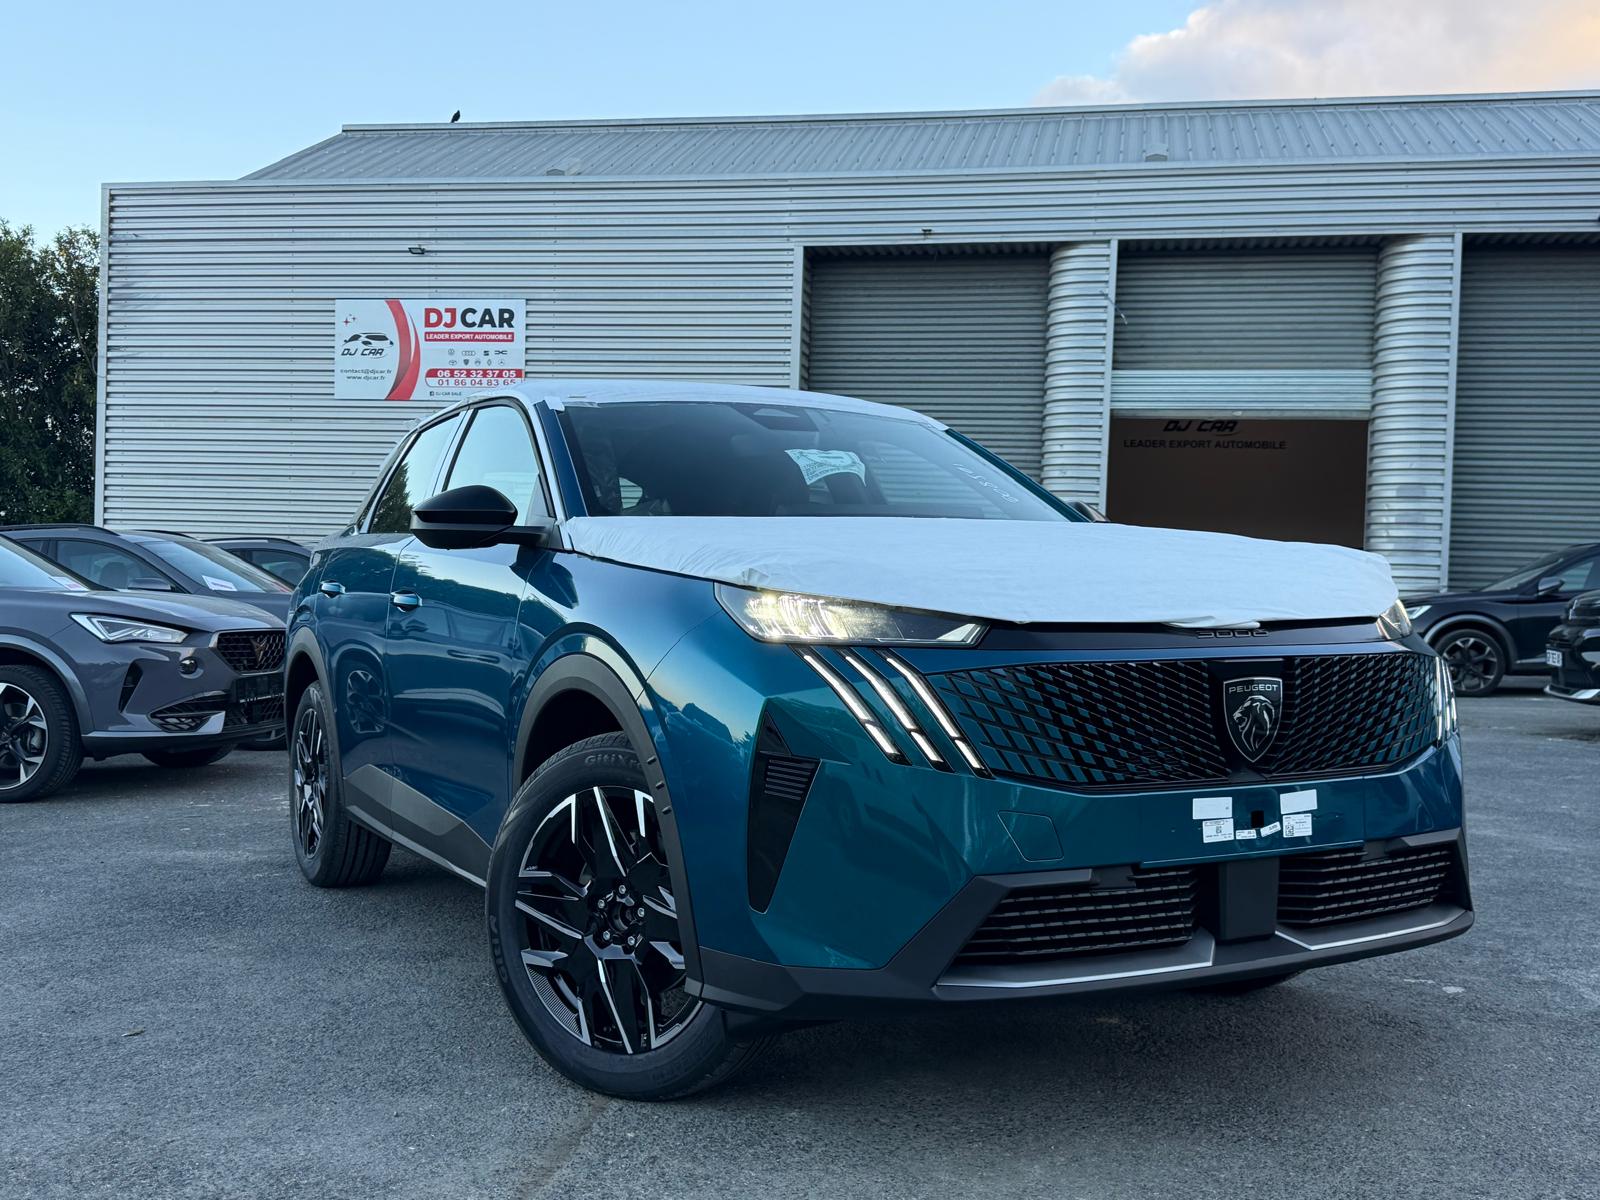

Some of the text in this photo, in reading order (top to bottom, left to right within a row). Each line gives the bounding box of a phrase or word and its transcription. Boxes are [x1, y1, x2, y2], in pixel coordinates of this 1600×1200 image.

[424, 308, 515, 328] DJ CAR
[341, 348, 384, 356] DJ CAR
[437, 370, 516, 378] 06 52 32 37 05
[1163, 420, 1239, 432] DJ CAR
[1123, 439, 1288, 450] LEADER EXPORT AUTOMOBILE
[1228, 684, 1279, 694] PEUGEOT
